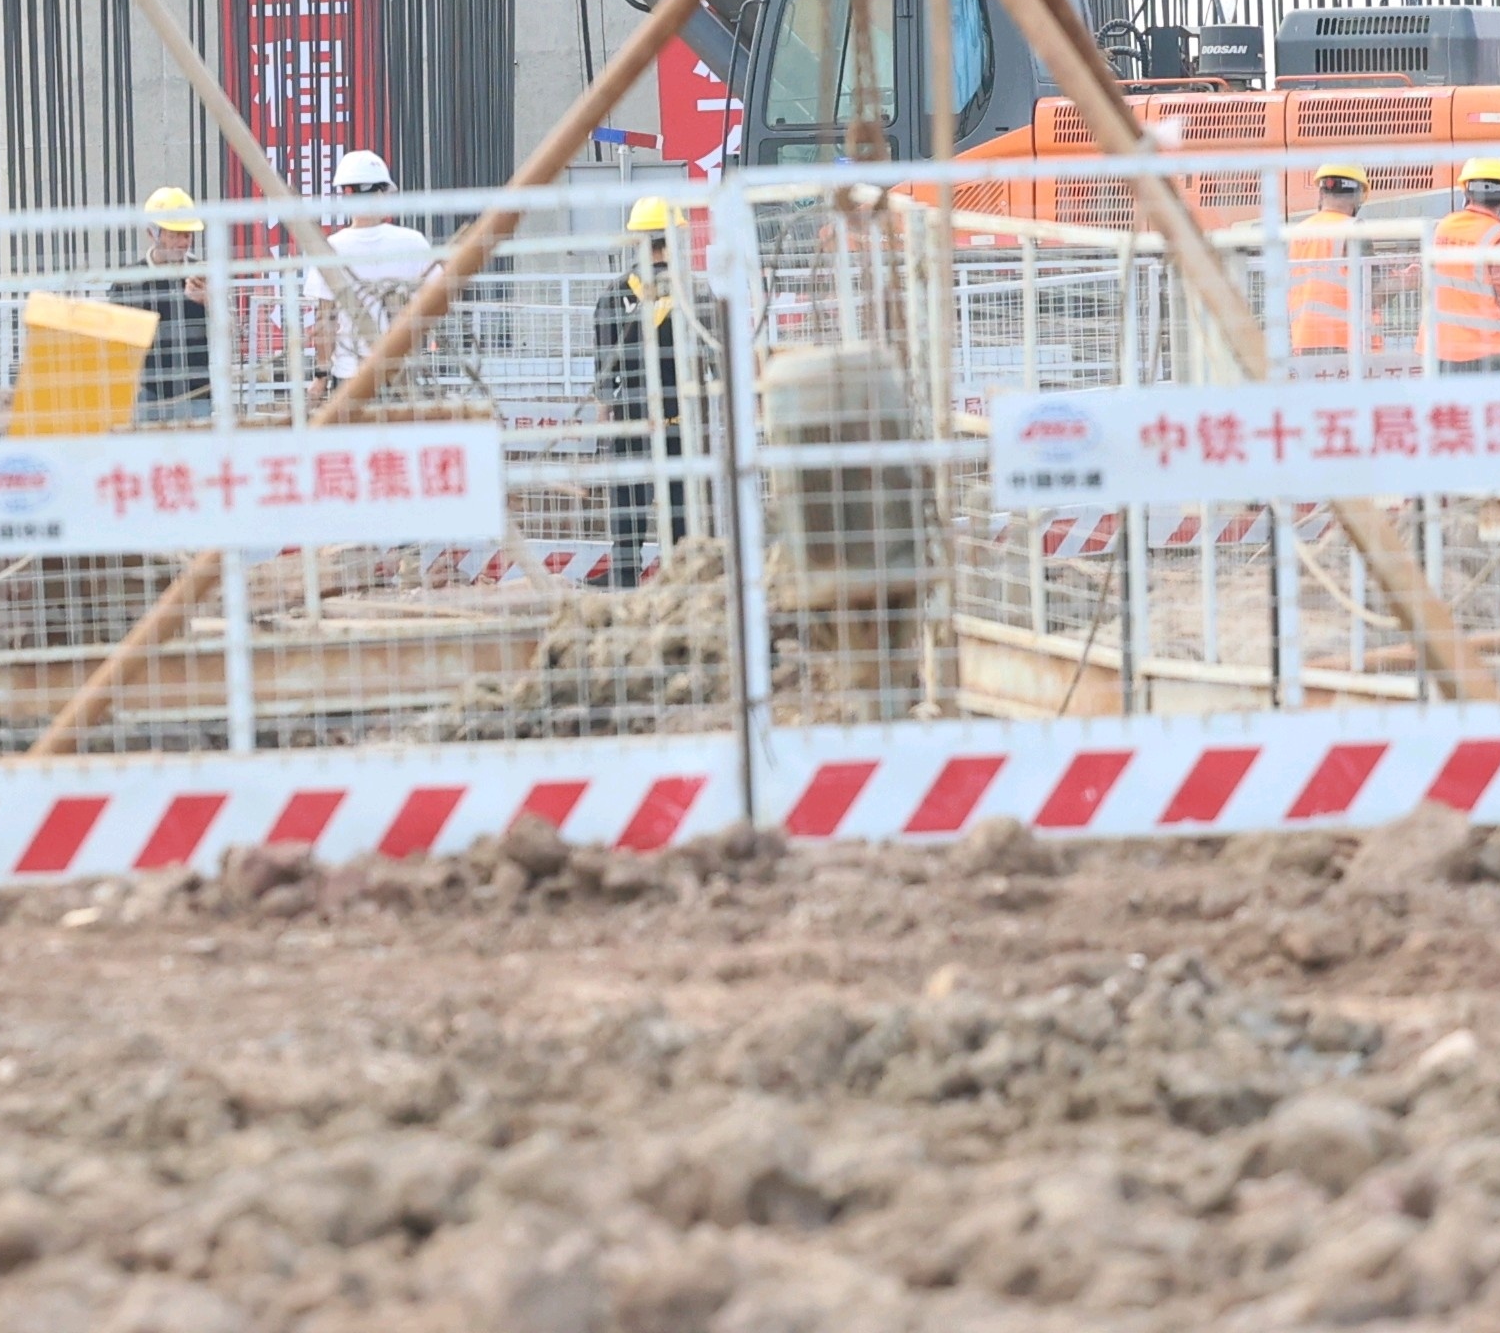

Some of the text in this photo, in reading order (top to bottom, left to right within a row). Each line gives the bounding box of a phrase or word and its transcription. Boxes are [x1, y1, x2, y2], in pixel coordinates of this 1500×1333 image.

[1201, 45, 1248, 54] DOOSAN
[96, 444, 468, 518] 中铁十五局集团
